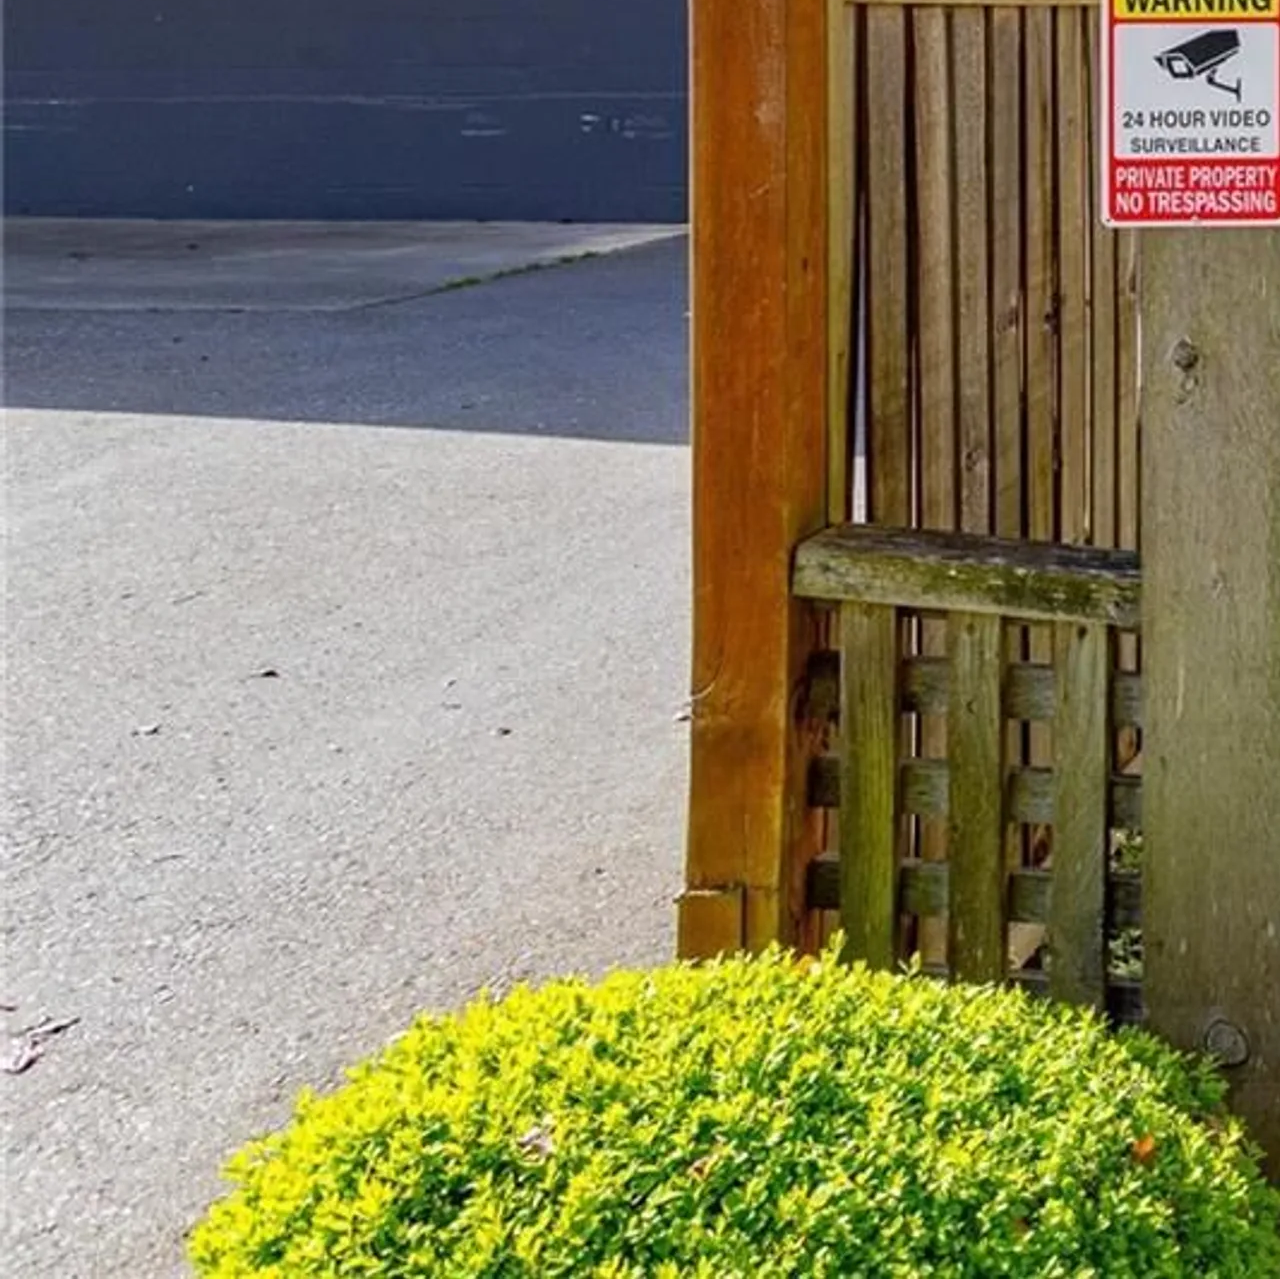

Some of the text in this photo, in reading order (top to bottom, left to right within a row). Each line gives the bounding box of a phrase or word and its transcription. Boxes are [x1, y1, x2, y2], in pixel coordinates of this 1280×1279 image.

[1122, 110, 1271, 128] 24 HOUR VIDEO
[1130, 136, 1262, 153] SURVEILLANCE
[1115, 167, 1277, 189] PRIVATE PROPERTY
[1115, 191, 1276, 214] NO TRESPASSING
